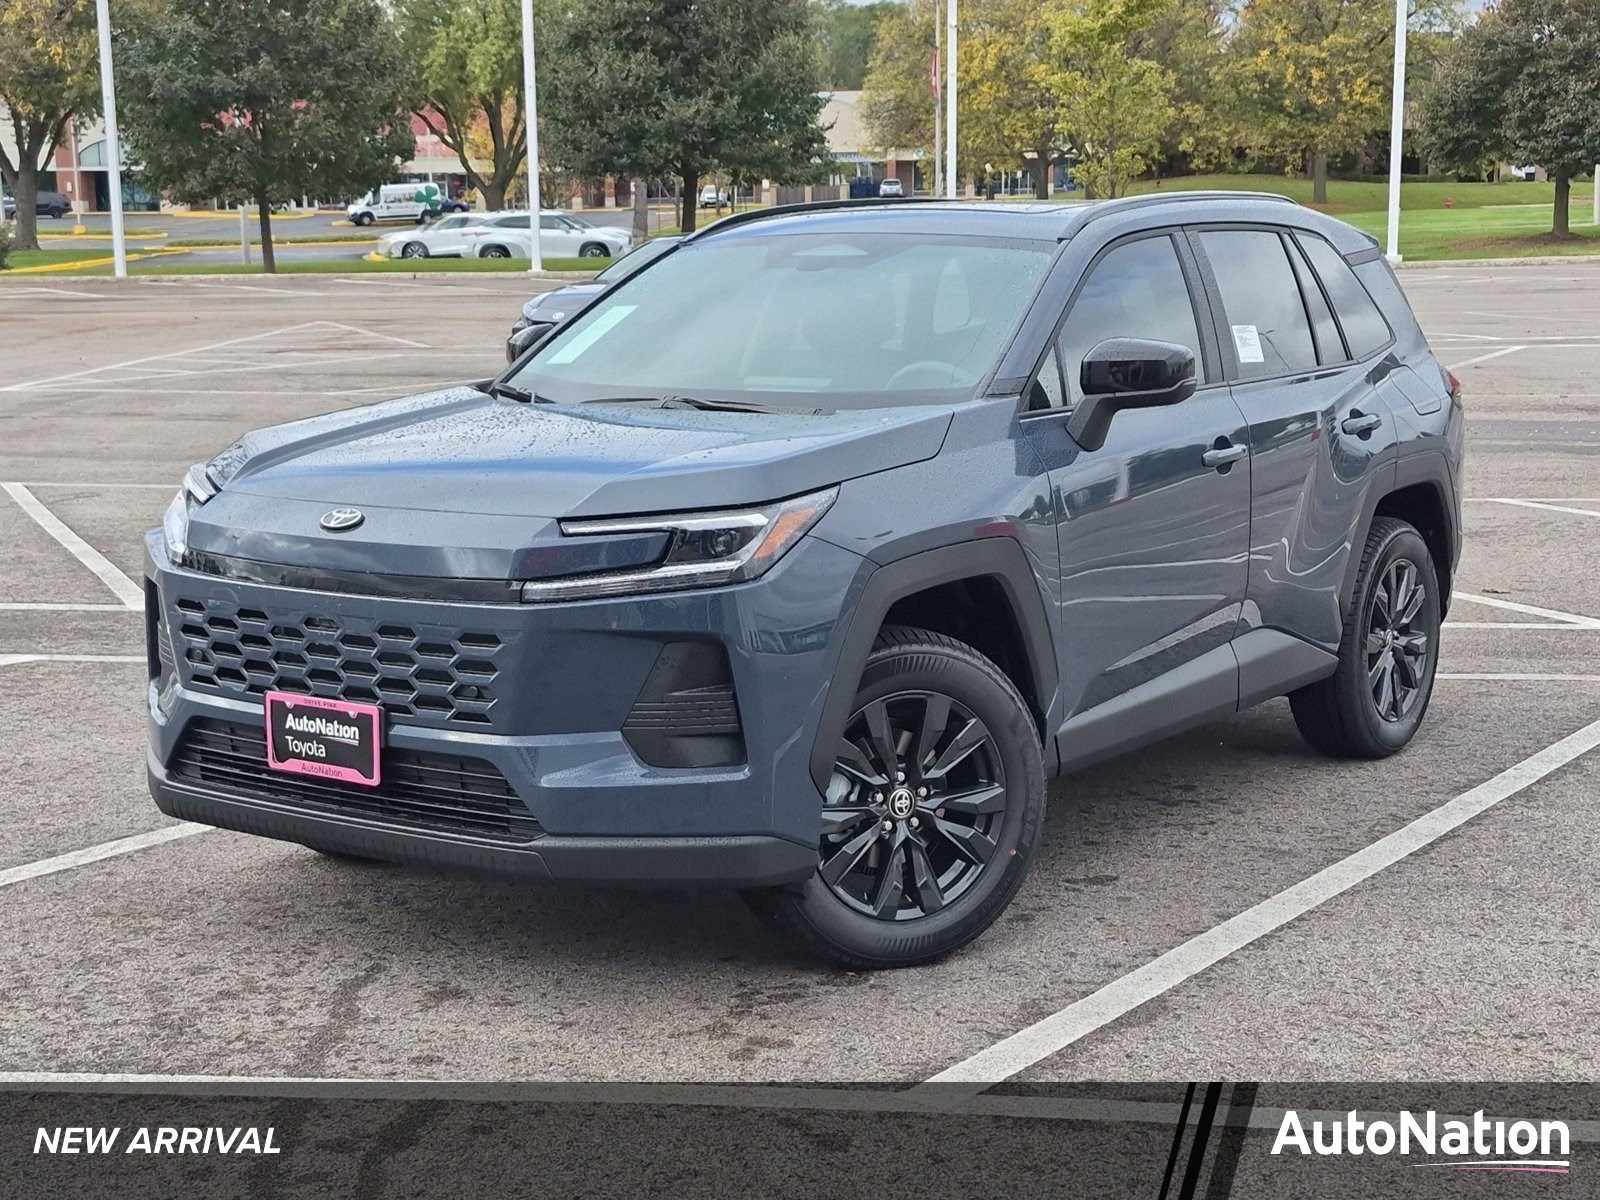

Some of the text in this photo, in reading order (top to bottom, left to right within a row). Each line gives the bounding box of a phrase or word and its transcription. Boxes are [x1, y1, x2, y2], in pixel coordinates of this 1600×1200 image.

[285, 713, 359, 740] AutoNation
[285, 735, 326, 757] Toyota
[301, 763, 343, 778] AutoNation
